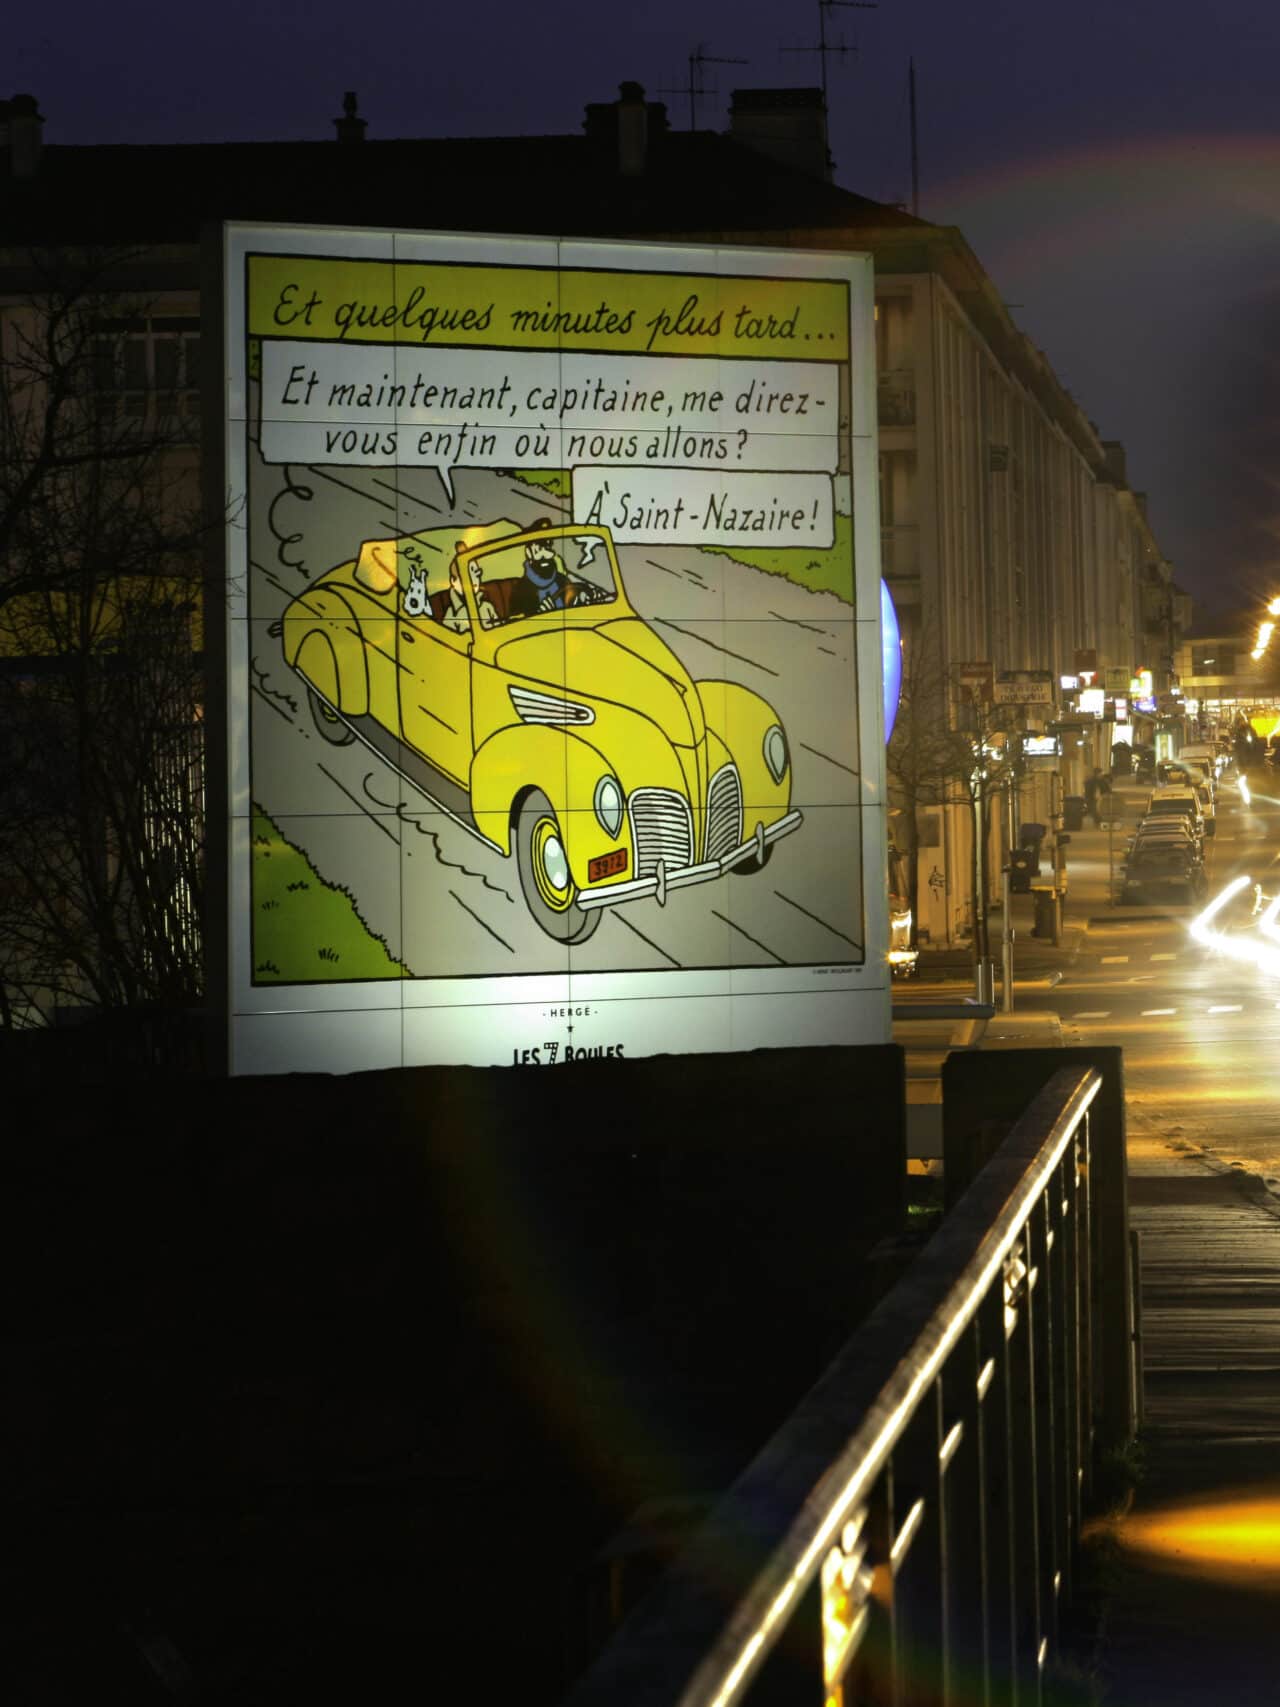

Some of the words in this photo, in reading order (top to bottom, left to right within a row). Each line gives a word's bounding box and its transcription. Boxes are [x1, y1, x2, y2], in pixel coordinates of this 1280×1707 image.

[273, 283, 323, 326] Et
[334, 285, 495, 341] quelques
[509, 301, 637, 334] minutes
[646, 294, 725, 350] plus
[734, 304, 836, 340] tard...
[281, 365, 319, 405] Et
[328, 372, 517, 417] maintenant,
[526, 378, 674, 419] capitaine,
[681, 388, 724, 412] me
[735, 379, 826, 414] direz-
[325, 430, 397, 455] vous
[418, 422, 496, 464] enfin
[515, 423, 550, 457] où
[567, 433, 638, 458] nous
[543, 1042, 559, 1064] 7
